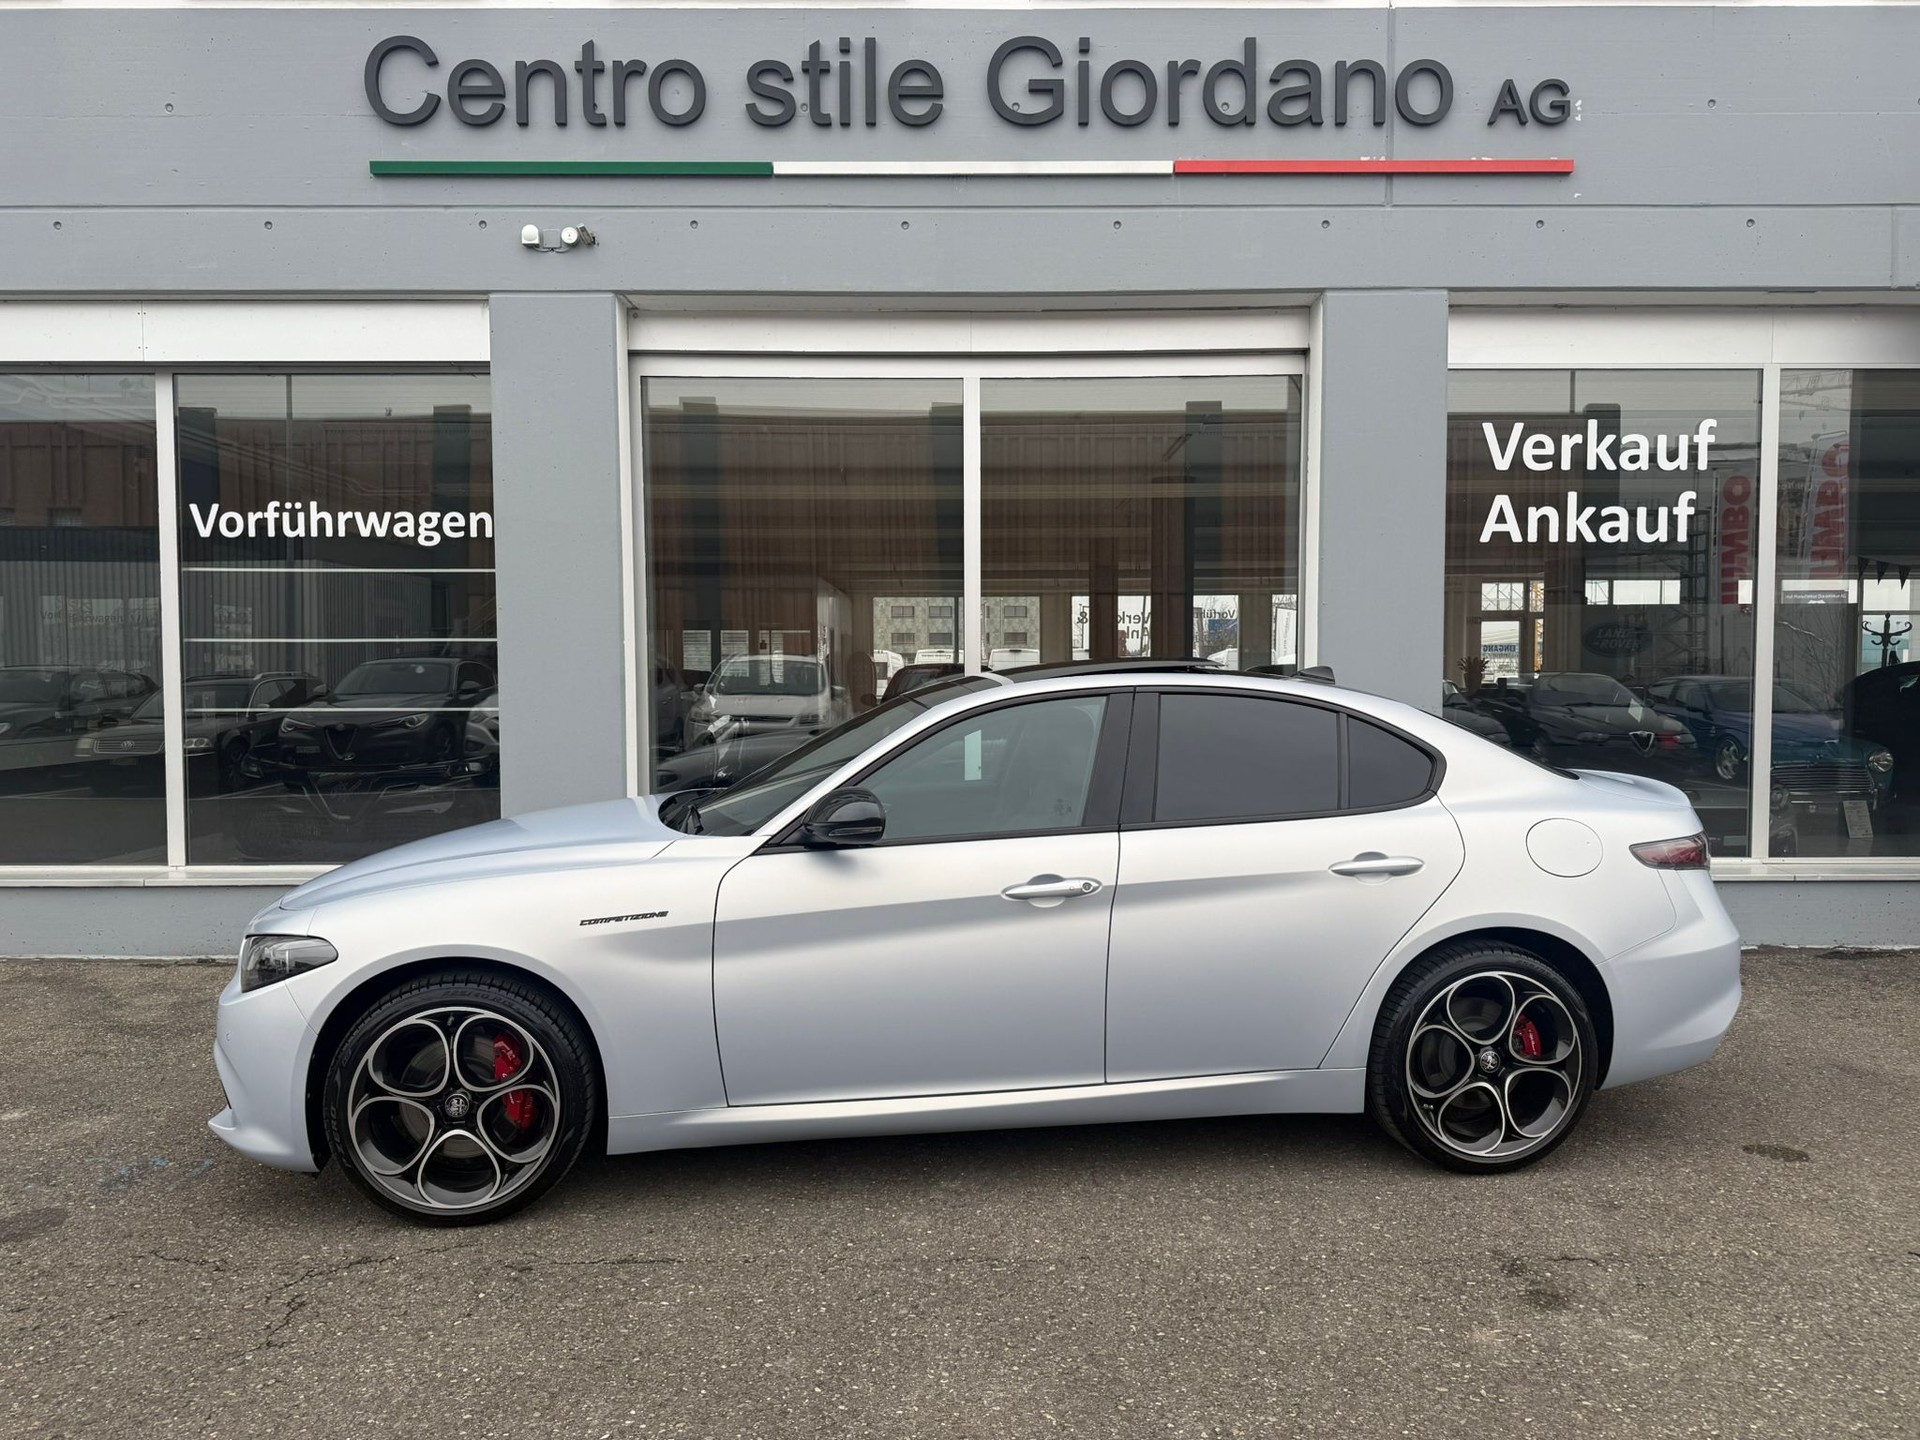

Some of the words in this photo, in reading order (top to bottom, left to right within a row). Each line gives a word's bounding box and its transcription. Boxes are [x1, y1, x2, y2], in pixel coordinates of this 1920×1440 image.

[364, 35, 707, 131] Centro
[745, 37, 944, 131] stile
[986, 35, 1454, 131] Giordano
[1487, 78, 1571, 129] AG
[1482, 418, 1717, 471] Verkauf
[189, 501, 493, 547] Vorführwagen
[1479, 490, 1697, 543] Ankauf
[579, 910, 669, 926] COMPETIZIONE
